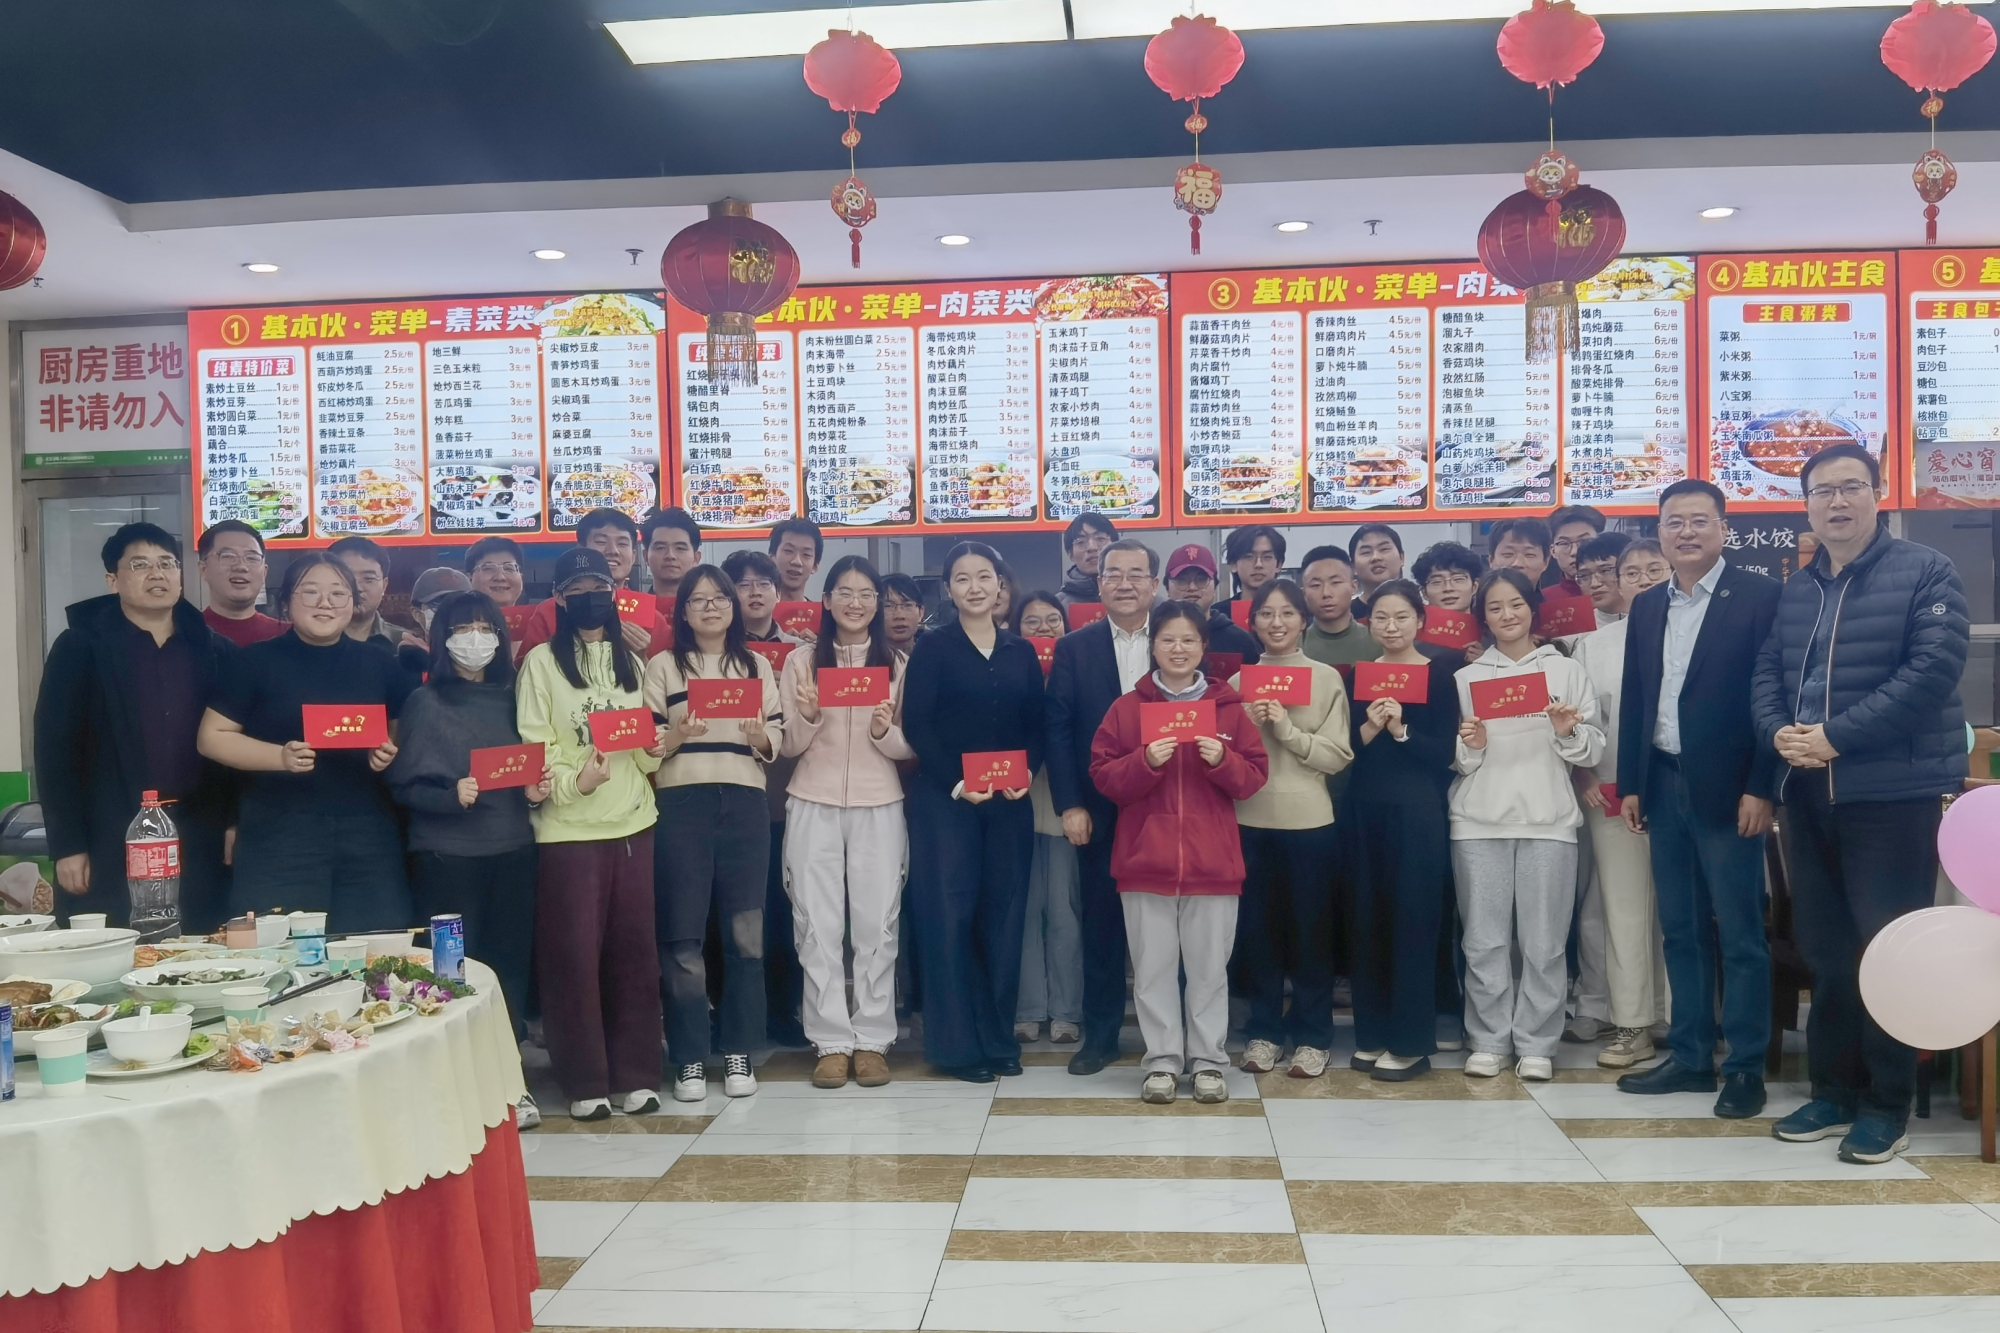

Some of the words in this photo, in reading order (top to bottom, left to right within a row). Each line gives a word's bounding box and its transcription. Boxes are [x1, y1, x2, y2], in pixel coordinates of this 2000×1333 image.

[1178, 168, 1217, 209] 福
[1742, 260, 1886, 288] 基本伙主食
[1443, 311, 1485, 323] 糖醋鱼块
[1759, 304, 1838, 322] 主食粥类
[1190, 319, 1251, 332] 蒜苗香干肉丝
[1315, 316, 1356, 327] 香辣肉丝
[927, 331, 976, 343] 海带炖鸡块
[1049, 327, 1088, 339] 玉米鸡丁
[1443, 328, 1474, 339] 溜丸子
[1719, 331, 1741, 342] 菜粥
[1917, 327, 1947, 339] 素包子
[806, 335, 873, 346] 肉末粉丝圆白菜
[1190, 333, 1251, 345] 鲜蘑菇鸡肉片
[433, 346, 461, 357] 地三鲜
[550, 342, 599, 353] 尖椒炒豆皮
[1049, 340, 1109, 353] 肉沫茄子豆角
[1316, 346, 1356, 358] 口磨肉片
[1443, 342, 1484, 354] 农家腊肉
[1917, 345, 1947, 356] 肉包子
[806, 349, 845, 360] 肉末海带
[1190, 347, 1251, 359] 芹菜香干炒肉
[1720, 351, 1751, 362] 小米粥
[38, 341, 184, 385] 厨房重地
[551, 359, 599, 371] 青笋炒鸡蛋
[928, 359, 966, 370] 肉炒藕片
[1050, 357, 1088, 368] 尖椒肉片
[1190, 361, 1231, 373] 肉片腐竹
[1315, 361, 1367, 372] 萝卜炖牛腩
[1443, 357, 1485, 368] 香菇鸡块
[1917, 361, 1947, 372] 豆沙包
[213, 360, 290, 377] 纯素特价菜
[317, 366, 373, 377] 西葫芦炒鸡蛋
[433, 364, 481, 374] 三色玉米粒
[807, 363, 855, 374] 肉炒萝卜丝
[1571, 364, 1613, 376] 排骨冬瓜
[928, 373, 967, 384] 酸菜白肉
[1190, 375, 1231, 386] 酱爆鸡丁
[1315, 376, 1346, 387] 过油肉
[1443, 372, 1485, 384] 孜然红肠
[1720, 370, 1751, 382] 紫米粥
[318, 381, 364, 392] 虾皮炒冬瓜
[433, 381, 482, 392] 炝炒西兰花
[807, 377, 846, 388] 土豆鸡块
[1571, 378, 1624, 390] 酸菜炖排骨
[1917, 378, 1937, 389] 糖包
[206, 383, 256, 394] 素炒土豆丝
[928, 386, 967, 397] 肉沫豆腐
[552, 394, 590, 405] 尖椒鸡蛋
[808, 391, 836, 401] 木须肉
[1316, 391, 1356, 402] 孜然鸡柳
[1720, 390, 1751, 402] 八宝粥
[1917, 394, 1948, 405] 紫薯包
[206, 397, 246, 408] 素炒豆芽
[318, 397, 374, 408] 西红柿炒鸡蛋
[434, 398, 473, 408] 苦瓜鸡蛋
[688, 401, 719, 412] 锅包肉
[1050, 401, 1100, 413] 农家小炒肉
[39, 391, 185, 433] 非请勿入
[1442, 403, 1473, 414] 清蒸鱼
[1571, 406, 1613, 417] 咖喱牛肉
[206, 411, 257, 422] 素炒圆白菜
[319, 412, 365, 423] 韭菜炒豆芽
[435, 415, 463, 425] 炒年糕
[552, 411, 581, 422] 炒合菜
[929, 413, 968, 424] 肉炒苦瓜
[1720, 410, 1752, 422] 绿豆粥
[1917, 410, 1948, 422] 核桃包
[688, 417, 720, 428] 红烧肉
[808, 417, 867, 428] 五花肉炖粉条
[1571, 420, 1614, 431] 辣子鸡块
[319, 428, 365, 438] 香辣土豆条
[435, 432, 473, 443] 鱼香茄子
[553, 429, 592, 440] 麻婆豆腐
[689, 432, 731, 444] 红烧排骨
[1050, 430, 1100, 442] 土豆红烧肉
[1721, 430, 1774, 442] 玉米南瓜粥
[1917, 427, 1948, 438] 粘豆包
[207, 439, 227, 450] 藕合
[319, 444, 356, 454] 番茄菜花
[553, 446, 602, 457] 丝瓜炒鸡蛋
[689, 448, 732, 460] 蜜汁鸭腿
[1051, 446, 1080, 457] 大盘鸡
[1571, 447, 1613, 459] 水煮肉片
[1721, 450, 1743, 461] 豆浆
[208, 453, 248, 464] 素炒冬瓜
[436, 466, 474, 477] 大葱鸡蛋
[690, 463, 721, 475] 白斩鸡
[1051, 461, 1080, 472] 毛血旺
[1316, 466, 1346, 476] 羊杂汤
[208, 467, 258, 478] 炝炒萝卜丝
[1191, 471, 1220, 482] 回锅肉
[1721, 470, 1752, 482] 鸡蛋汤
[209, 482, 249, 493] 红烧南瓜
[437, 484, 475, 494] 山药木耳
[554, 480, 613, 491] 鱼香脆皮豆腐
[690, 479, 732, 491] 红烧牛肉
[210, 496, 249, 506] 白菜豆腐
[691, 495, 744, 506] 黄豆烧猪蹄
[209, 509, 259, 520] 黄瓜炒鸡蛋
[321, 505, 358, 516] 家常豆腐
